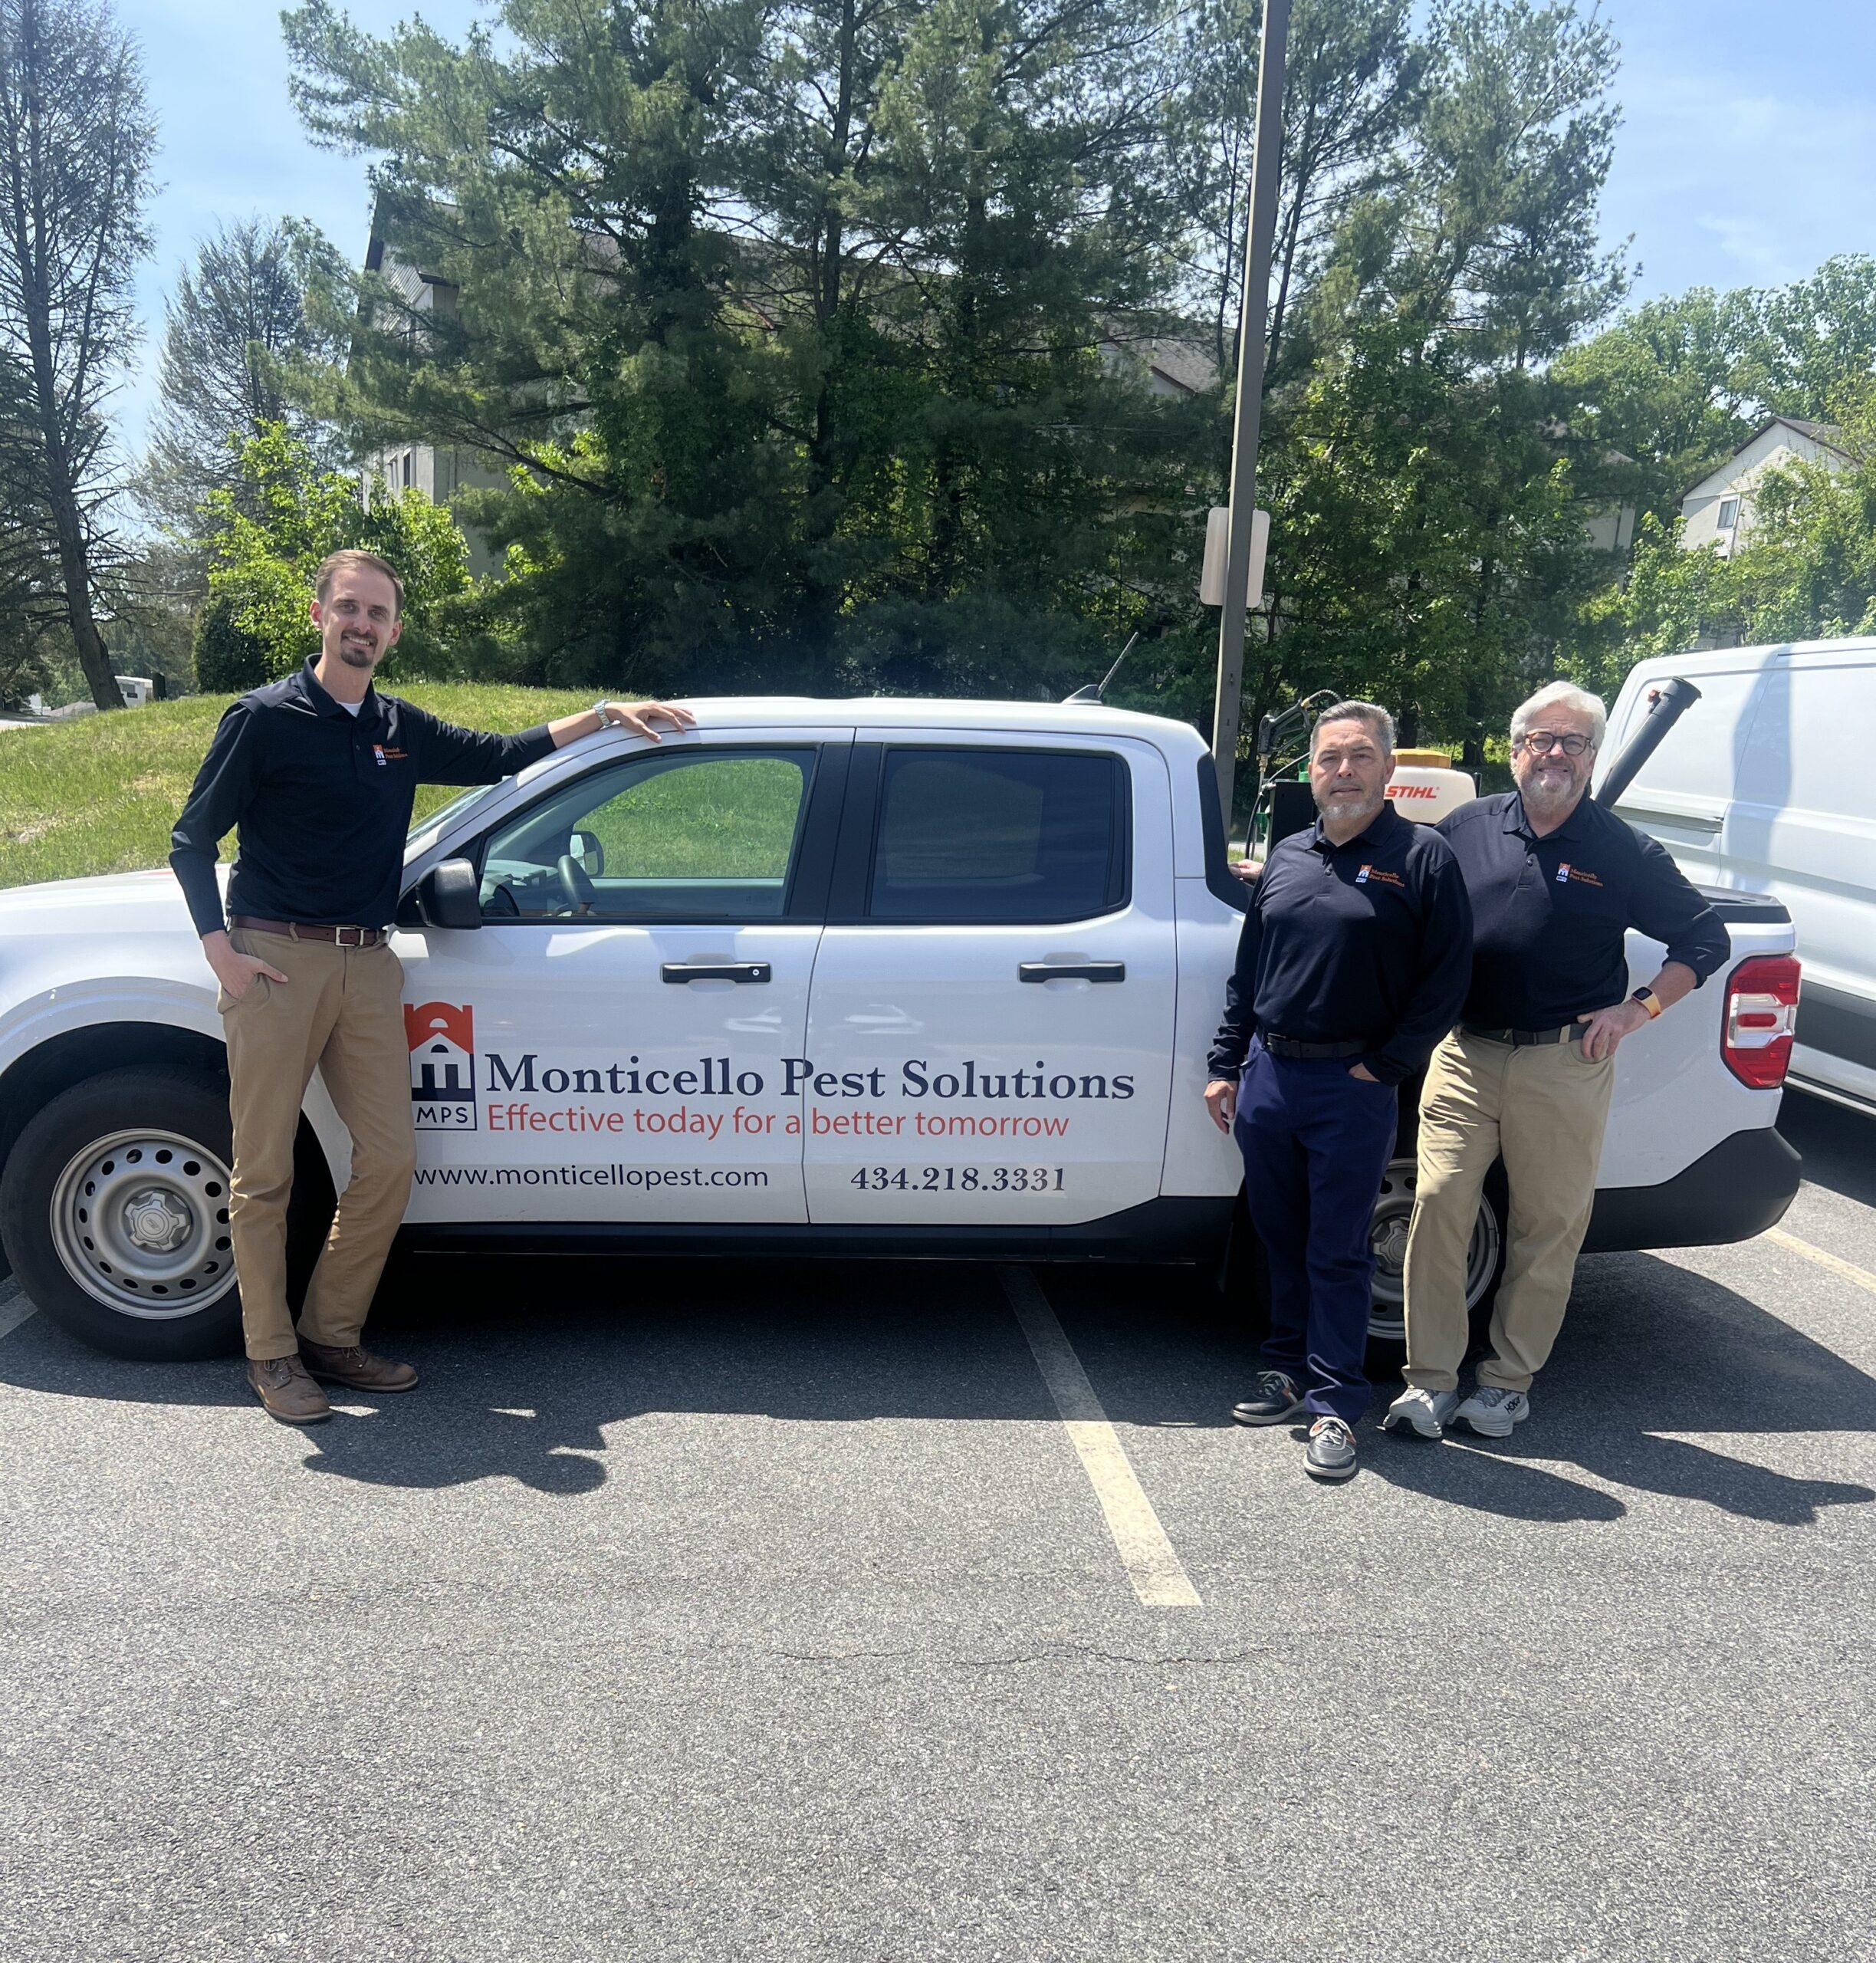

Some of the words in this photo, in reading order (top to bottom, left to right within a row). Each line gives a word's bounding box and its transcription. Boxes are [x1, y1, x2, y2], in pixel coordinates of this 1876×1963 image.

[1385, 785, 1437, 799] STIHL
[484, 1054, 764, 1097] Monticello
[780, 1058, 886, 1098] Pest
[902, 1060, 1135, 1100] Solutions
[416, 1106, 468, 1124] MPS
[488, 1103, 624, 1132] Effective
[633, 1106, 724, 1141] today
[733, 1106, 776, 1134] for
[785, 1116, 801, 1134] a
[812, 1108, 906, 1136] better
[915, 1113, 1069, 1137] tomorrow
[414, 1163, 768, 1192] www.monticellopest.com
[850, 1166, 1065, 1192] 434.218.3331
